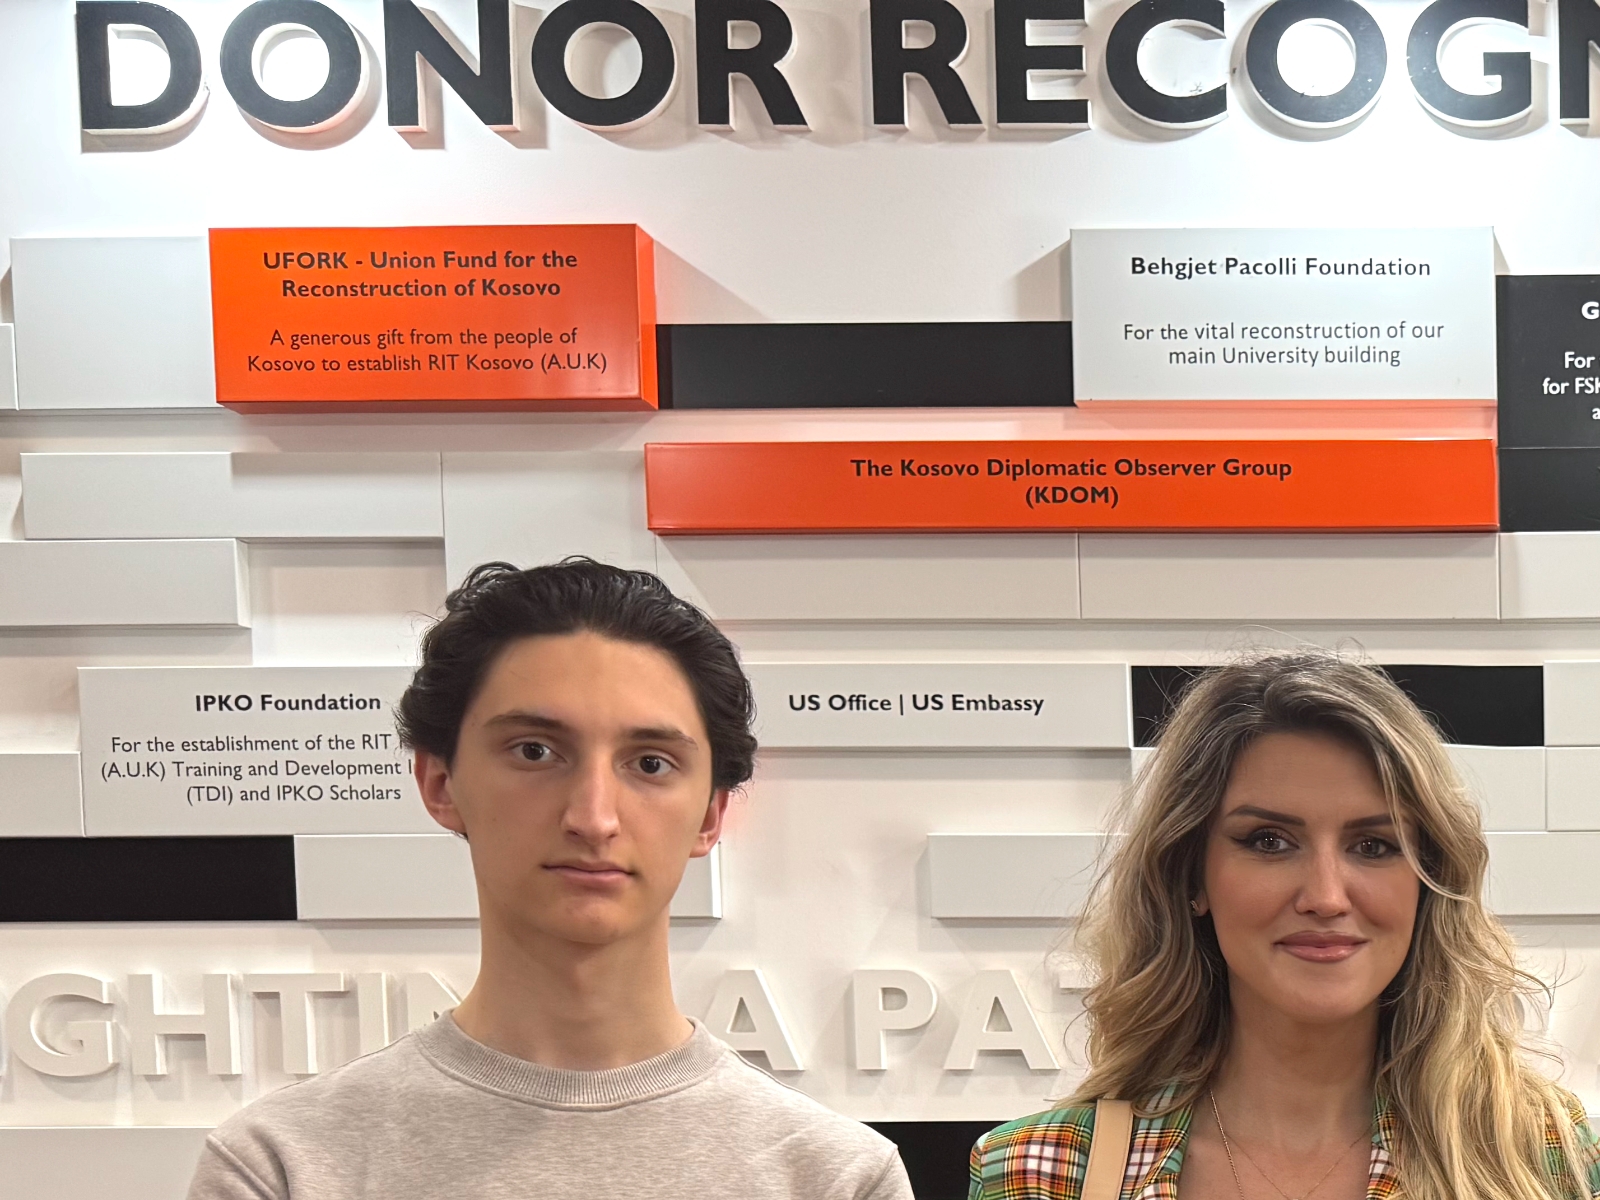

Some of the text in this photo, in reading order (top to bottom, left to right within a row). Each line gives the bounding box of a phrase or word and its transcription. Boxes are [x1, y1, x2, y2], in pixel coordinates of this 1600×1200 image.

[76, 0, 812, 131] DONOR
[263, 249, 578, 270] UFORK Union Fund for the
[1131, 256, 1431, 281] Behgjet Pacolli Foundation
[282, 278, 561, 298] Reconstruction of Kosovo
[269, 326, 578, 351] A generous gift from the people of
[1124, 320, 1445, 341] For the vital reconstruction of our
[247, 352, 607, 375] Kosovo to establish RIT Kosovo (A.U.K)
[1169, 345, 1401, 368] main University building
[1564, 351, 1596, 369] For
[1542, 377, 1570, 395] for
[849, 458, 1292, 482] The Kosovo Diplomatic Observer Group
[1025, 485, 1119, 510] (KDOM)
[195, 693, 381, 712] IPKO Foundation
[788, 693, 1045, 716] US Office US Embassy
[111, 736, 142, 753] For
[146, 736, 175, 753] the
[181, 734, 300, 752] establishment
[304, 734, 323, 751] of
[327, 734, 356, 751] the
[361, 733, 392, 750] RIT
[101, 760, 166, 783] (A.U.K)
[171, 760, 243, 781] Training
[247, 759, 279, 777] and
[285, 759, 402, 780] Development
[186, 783, 402, 807] (TDI) and IPKO Scholars
[722, 968, 806, 1071] A
[854, 968, 1100, 1072] PA
